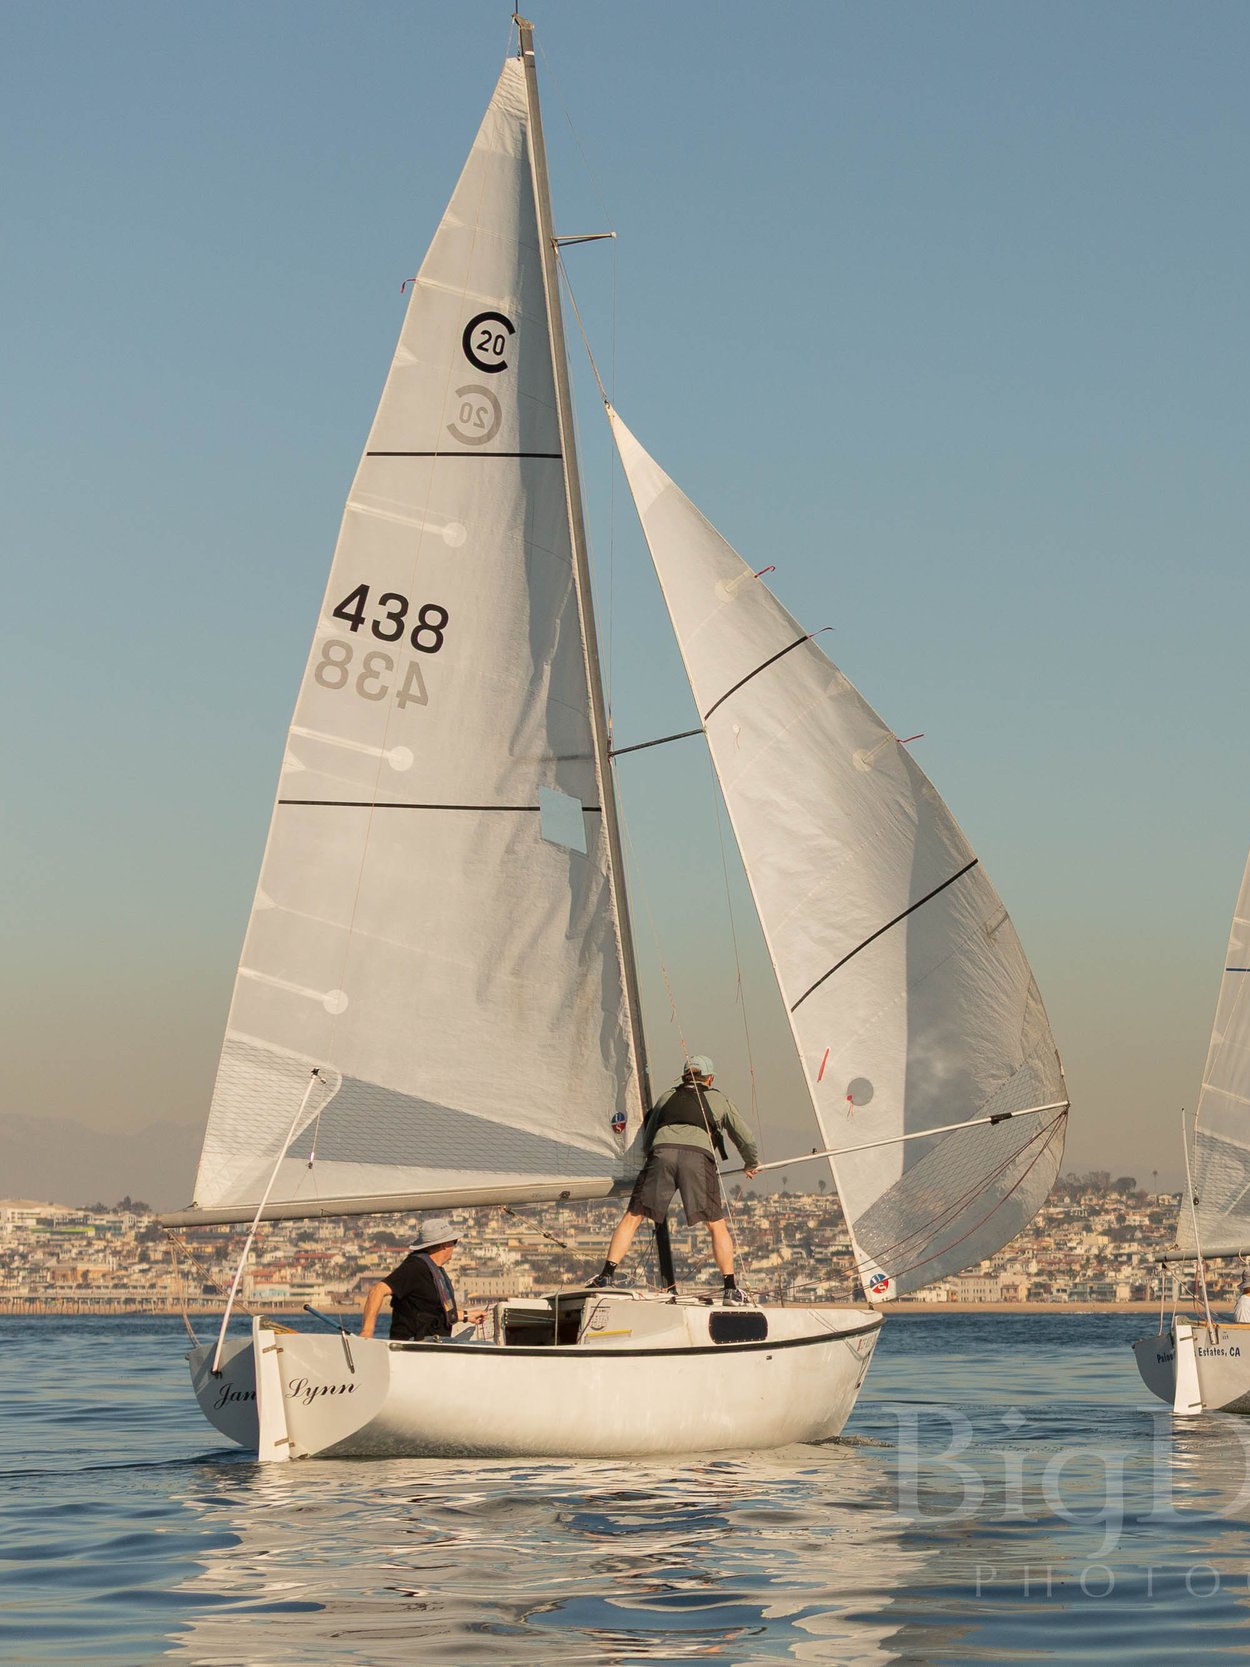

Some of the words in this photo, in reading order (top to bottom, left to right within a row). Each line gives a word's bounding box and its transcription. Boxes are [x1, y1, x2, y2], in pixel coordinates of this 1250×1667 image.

[462, 311, 516, 374] C
[476, 329, 505, 356] 20
[332, 583, 449, 654] 438
[1198, 1347, 1228, 1357] Estates,
[1229, 1346, 1241, 1357] CA
[284, 1377, 362, 1406] Lynn
